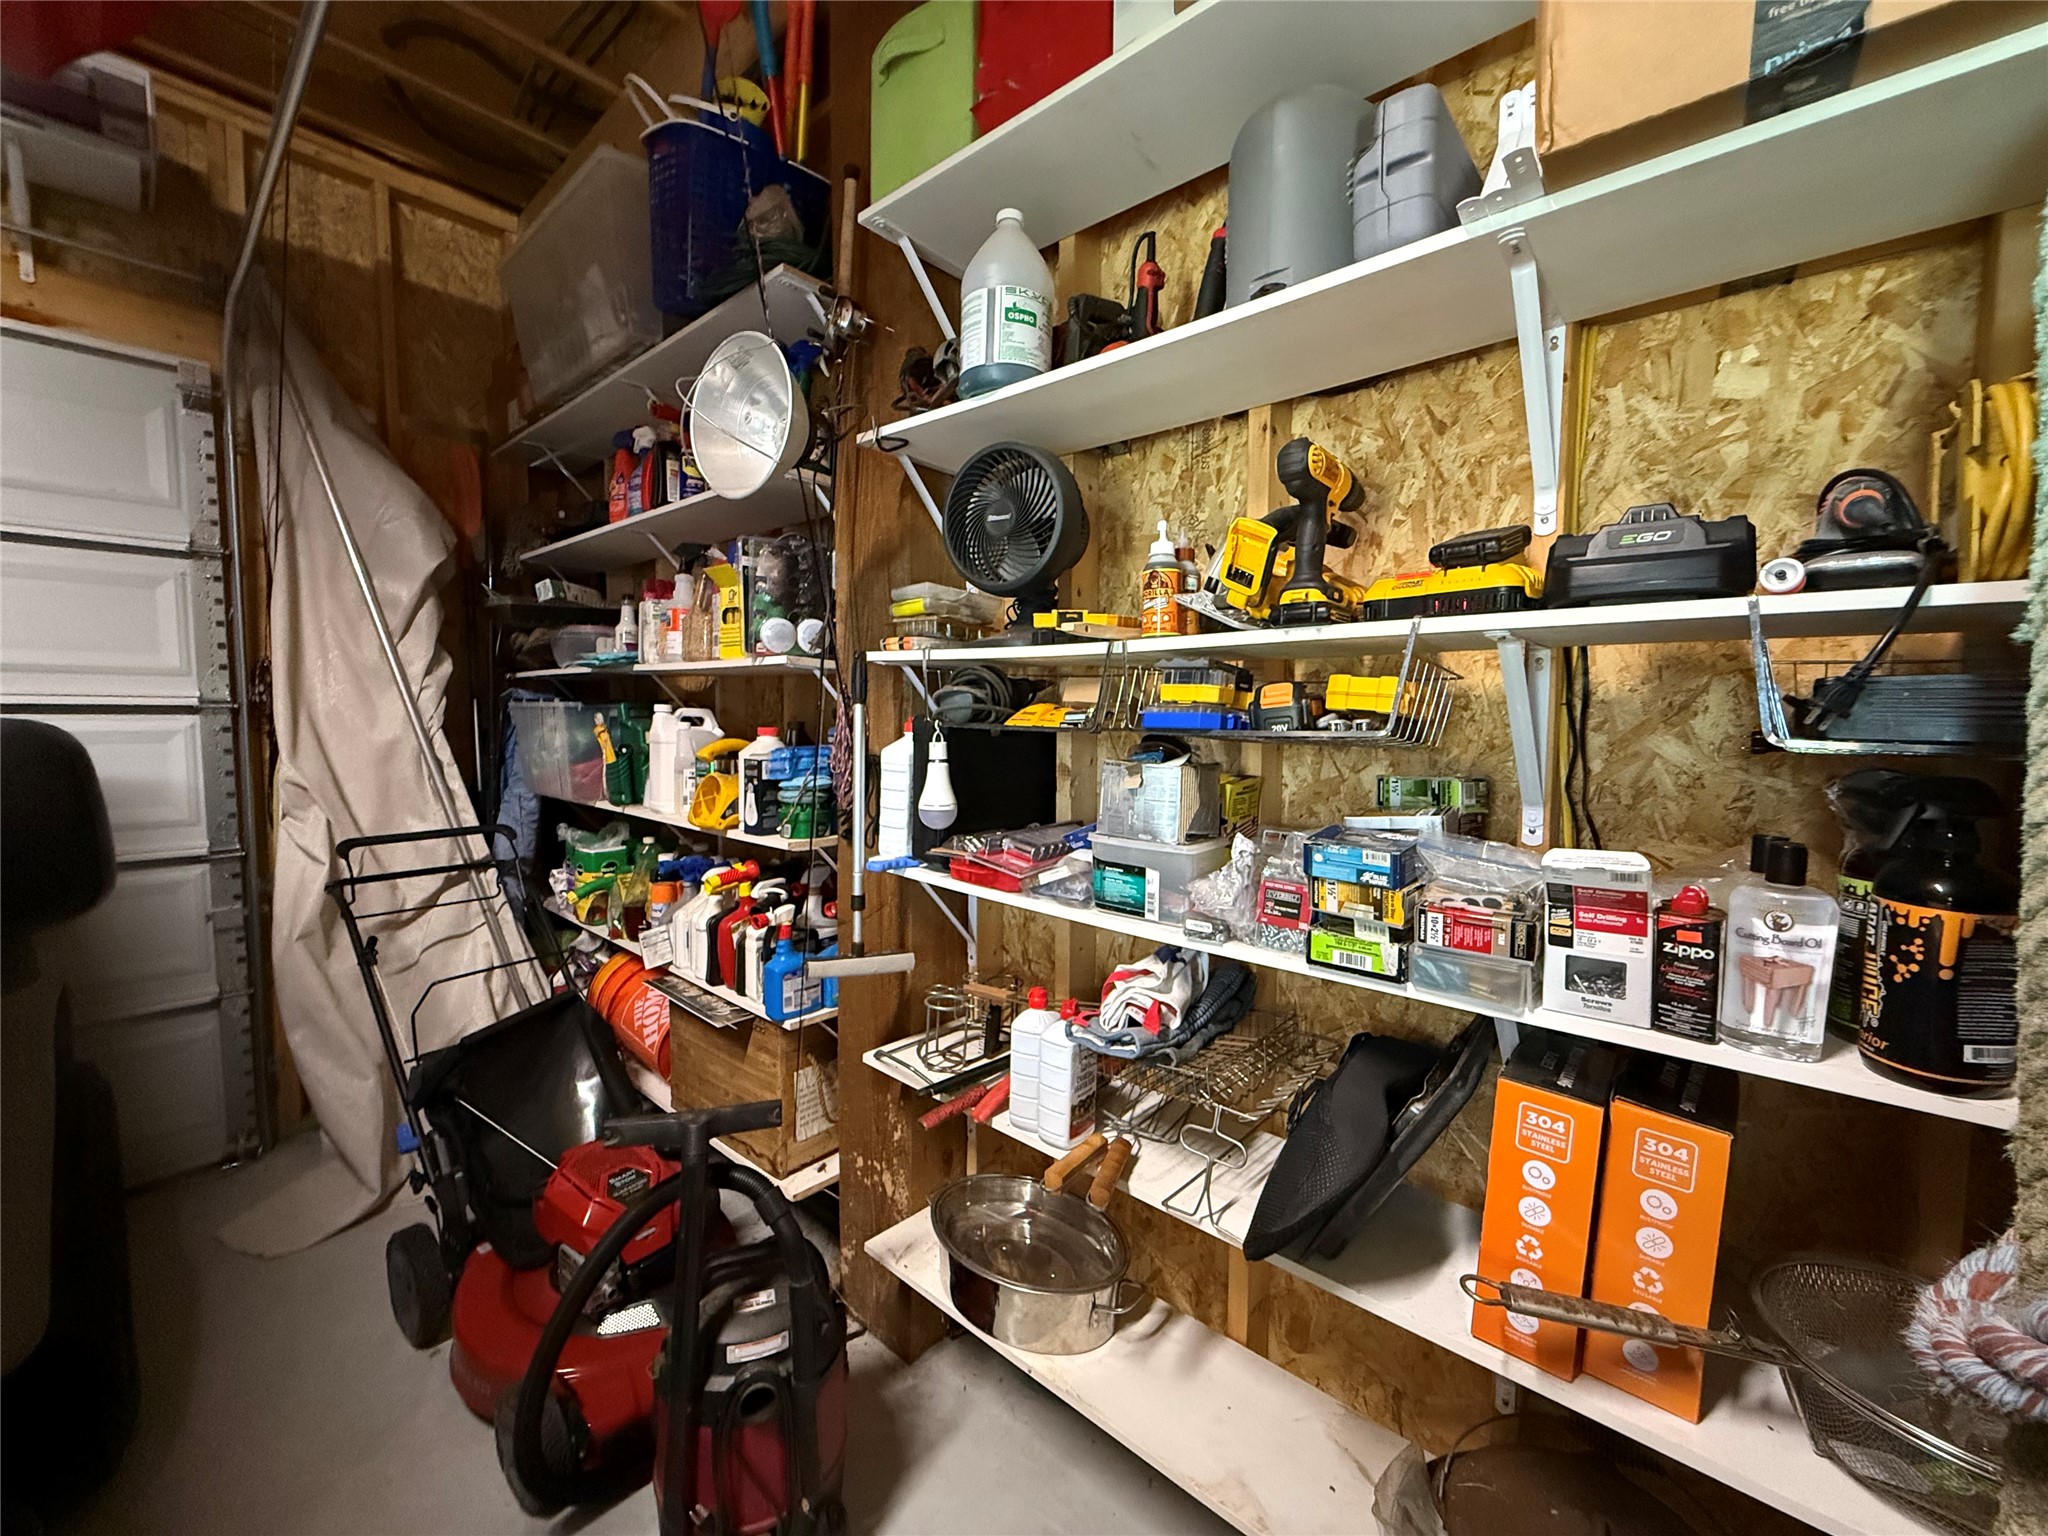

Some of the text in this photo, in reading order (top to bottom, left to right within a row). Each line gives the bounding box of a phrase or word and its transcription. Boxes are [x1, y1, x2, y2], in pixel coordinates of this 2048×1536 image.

[1768, 2, 1796, 18] free
[1007, 311, 1035, 324] OSPHO
[1619, 530, 1672, 545] EGO
[1271, 723, 1288, 732] 20V
[1578, 911, 1595, 919] Self
[1596, 913, 1628, 924] Drilling
[1735, 927, 1823, 949] Cutting Board Oil
[1662, 941, 1715, 960] zippo
[1581, 996, 1612, 1007] Screws
[1582, 1002, 1611, 1013] Tornillos
[1859, 1029, 1889, 1050] erior
[1525, 1110, 1566, 1134] 304
[1521, 1128, 1566, 1149] STAINLESS
[1530, 1139, 1555, 1153] STEEL
[1643, 1137, 1689, 1162] 304
[1639, 1156, 1690, 1178] STAINLESS
[1649, 1167, 1677, 1182] STEEL
